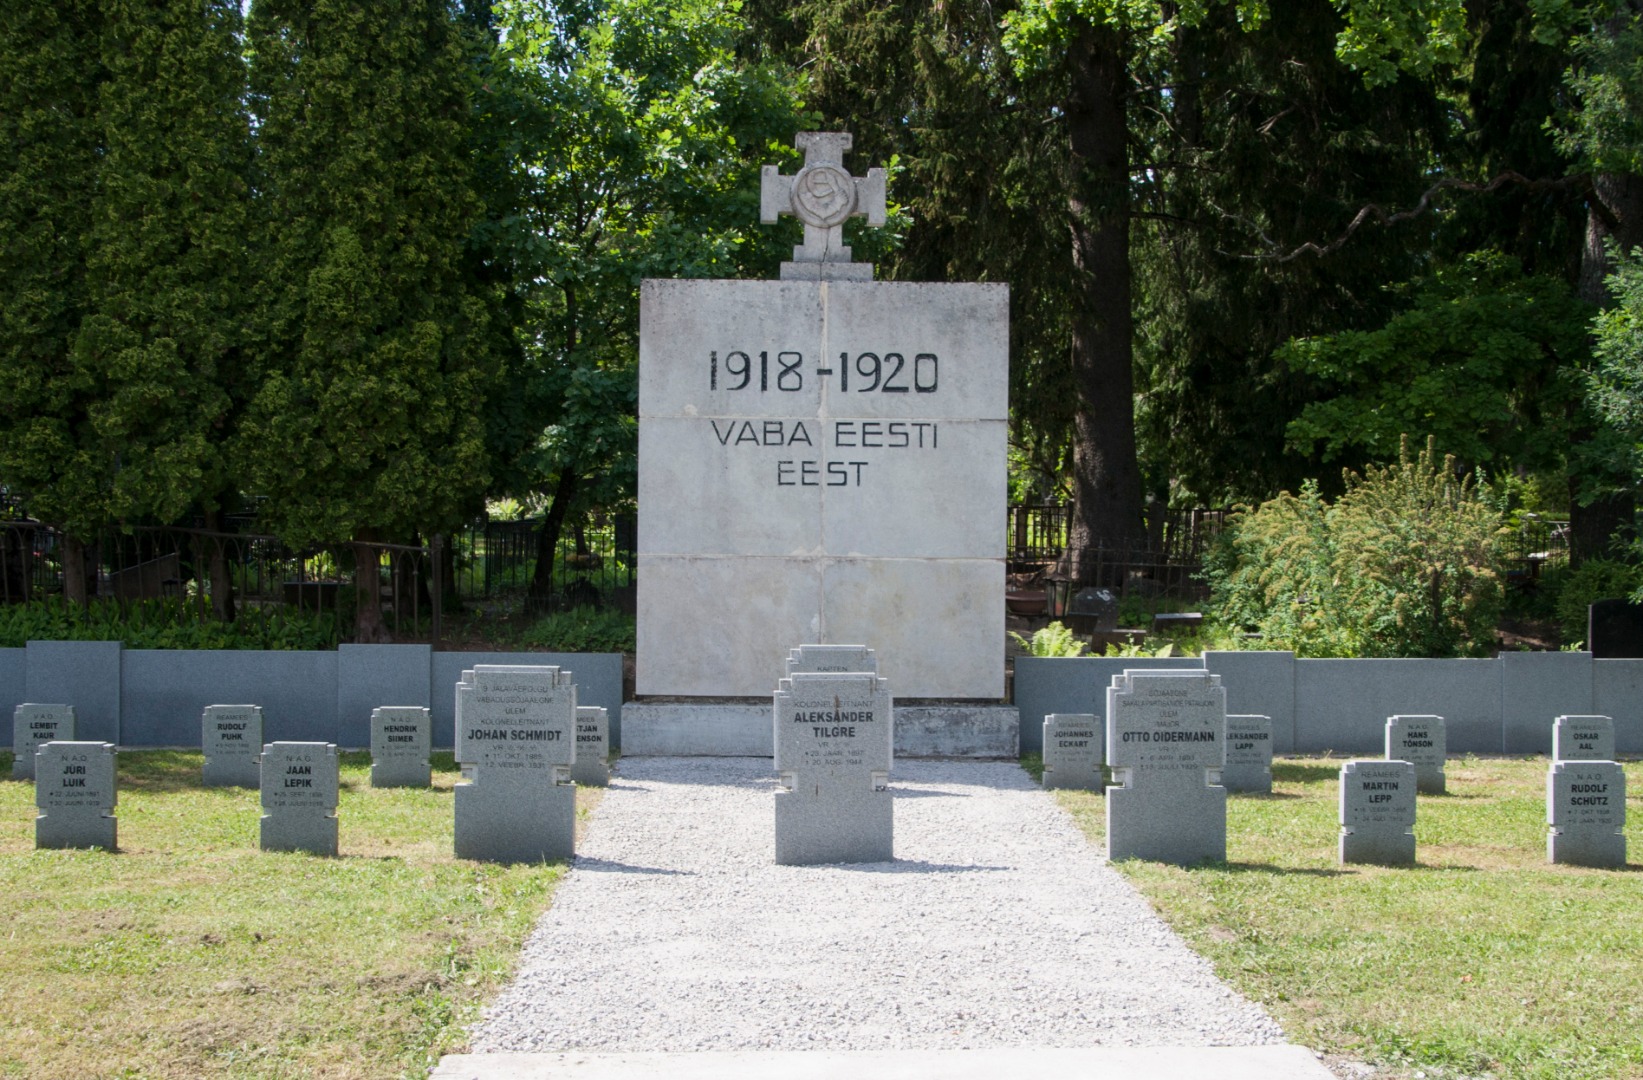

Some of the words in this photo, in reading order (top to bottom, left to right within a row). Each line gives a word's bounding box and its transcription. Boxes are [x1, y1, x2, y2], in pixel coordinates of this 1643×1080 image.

[710, 420, 813, 447] VABA
[835, 421, 938, 449] EESTI
[777, 460, 869, 487] EEST
[793, 711, 874, 723] ALEKSANDER
[30, 722, 58, 730] LEMBIT
[383, 725, 418, 733] HENDRIK
[467, 729, 507, 741] JOHAN
[510, 729, 562, 741] SCHMIDT
[812, 726, 856, 738] TILGRE
[1053, 730, 1094, 738] JOHANNES
[1122, 731, 1150, 742] OTTO
[1153, 731, 1215, 742] OIDERMANN
[1407, 731, 1428, 739] HANS
[1058, 740, 1089, 748] ECKART
[1234, 742, 1254, 750] LAPP
[286, 765, 312, 775] JAAN
[62, 778, 86, 788] LUIK
[284, 778, 312, 788] LEPIK
[1362, 782, 1399, 791] MARTIN
[1571, 784, 1608, 793] RUDOLF
[1368, 794, 1392, 803] LEPP
